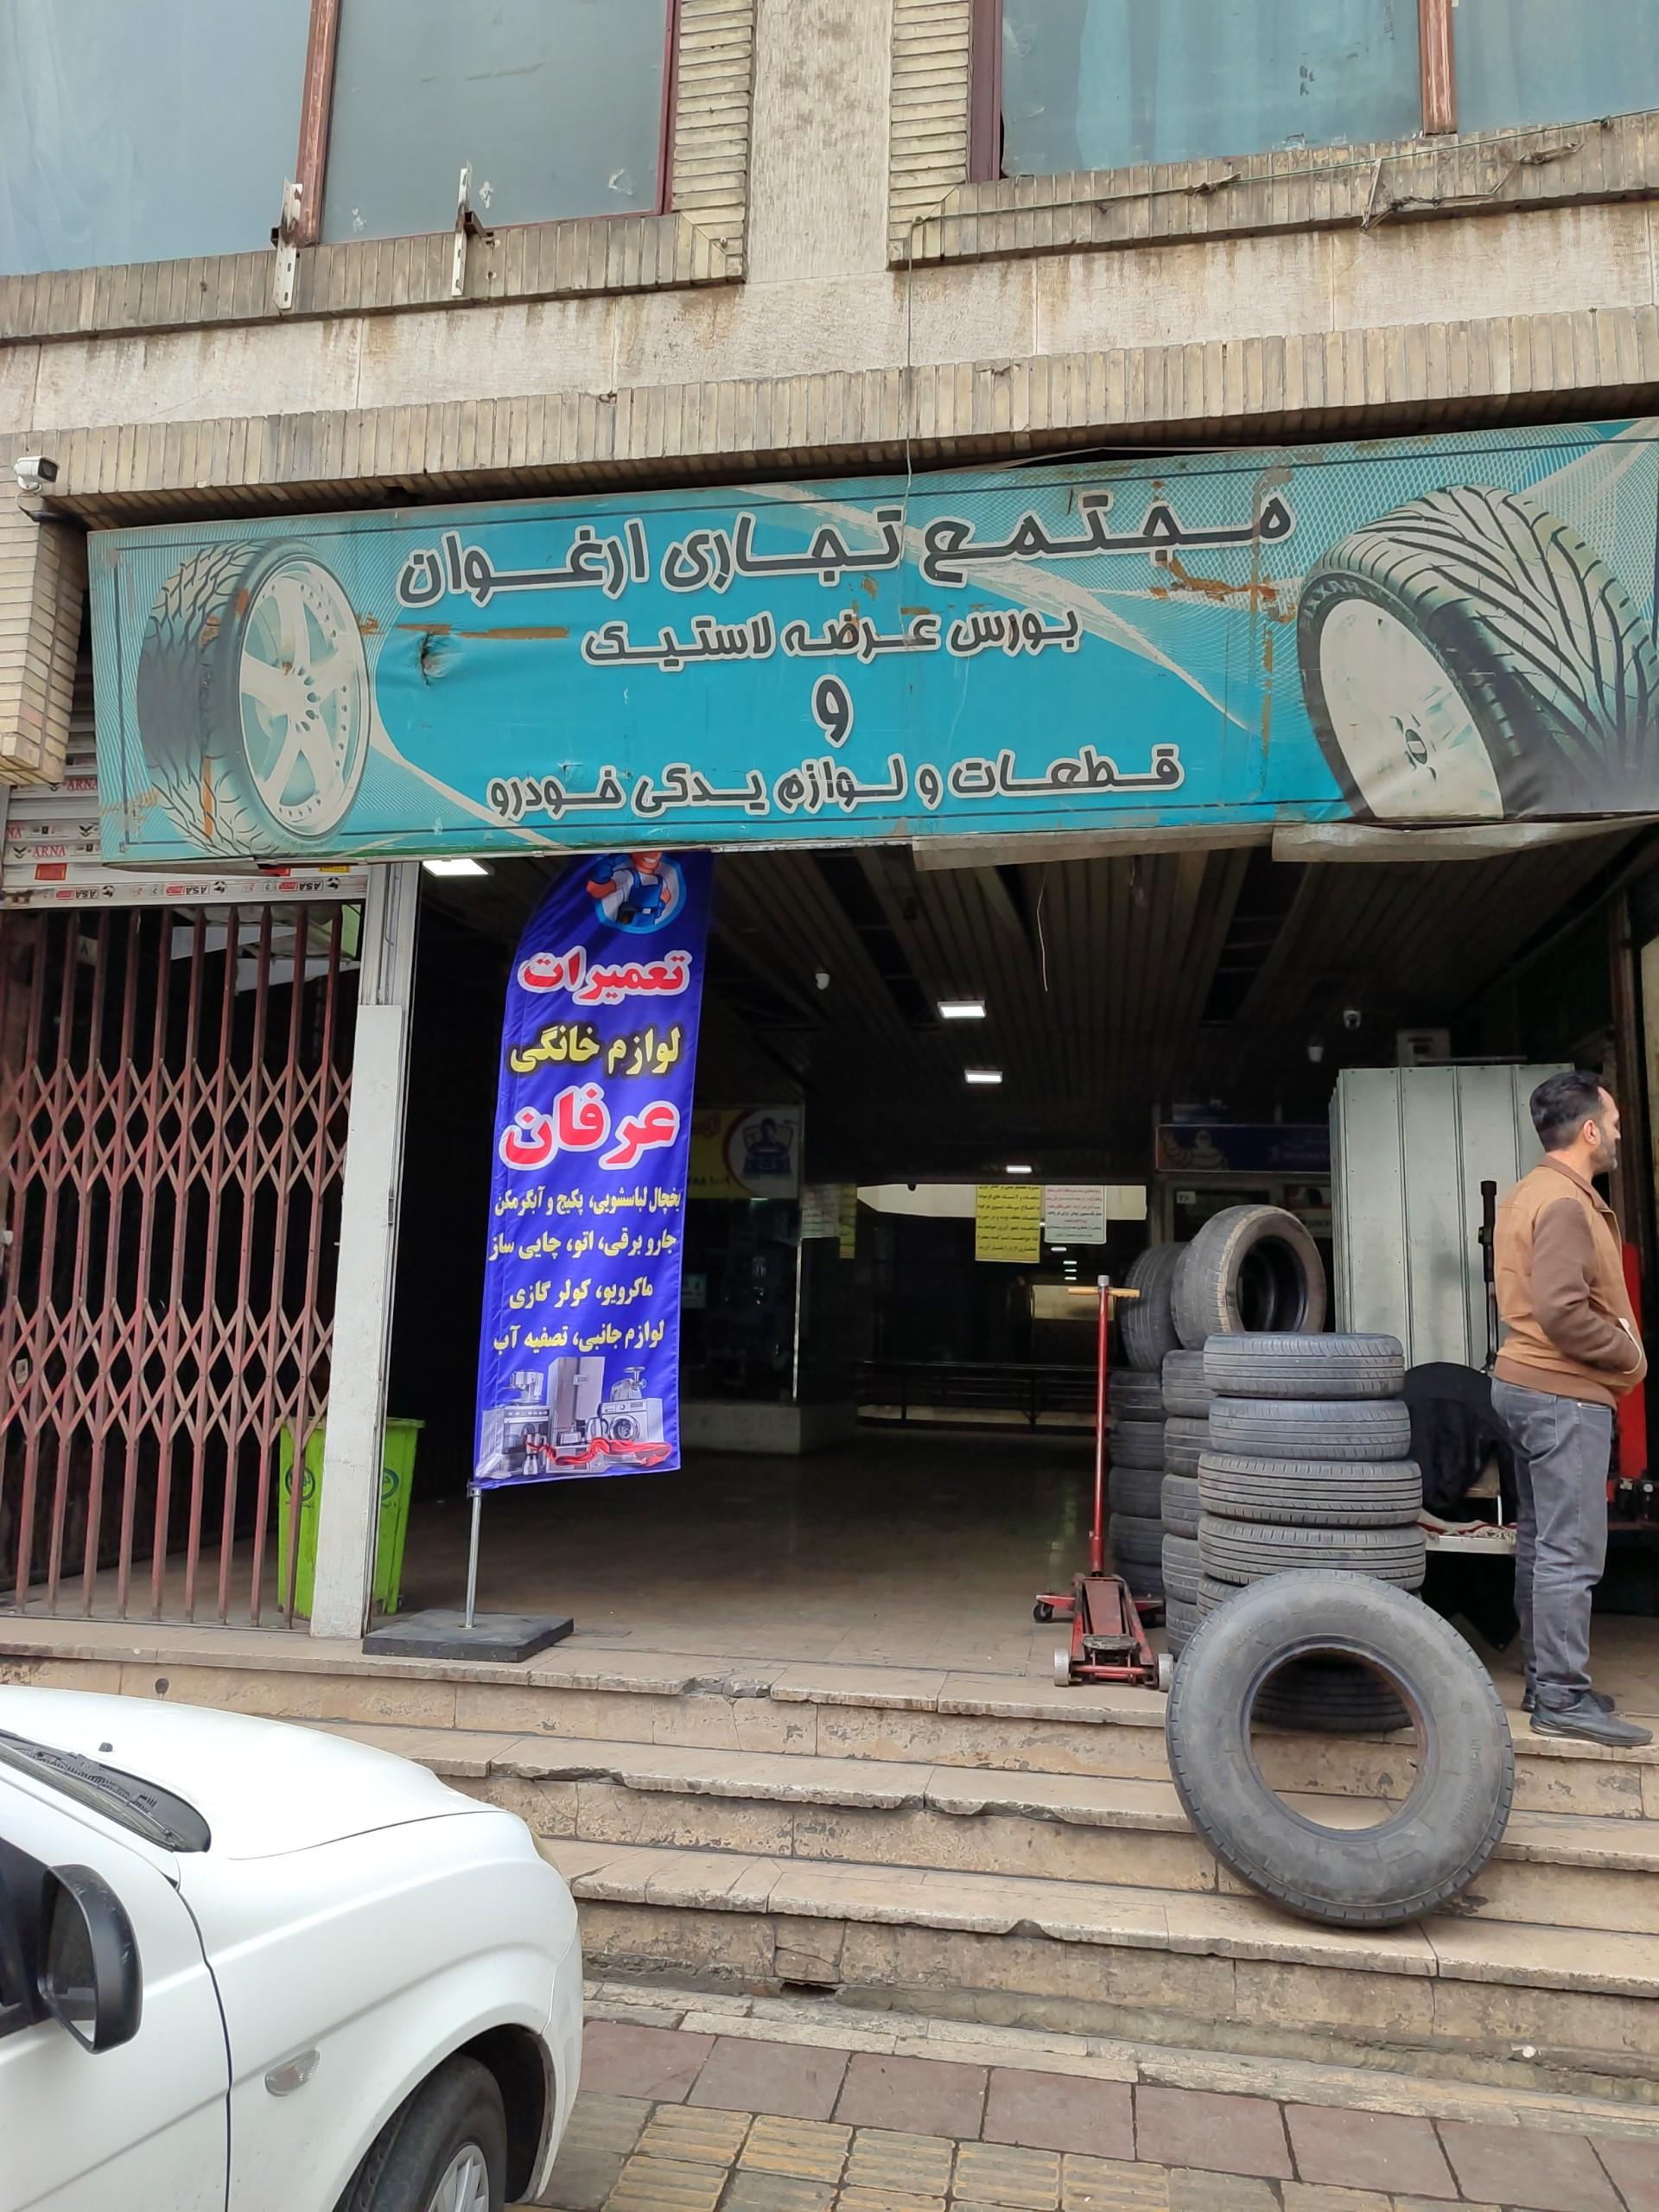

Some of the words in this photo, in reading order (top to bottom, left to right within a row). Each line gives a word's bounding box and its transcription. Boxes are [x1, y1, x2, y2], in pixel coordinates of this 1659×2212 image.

[396, 518, 648, 607] ارغوان
[661, 506, 906, 593] تجاری
[921, 490, 1296, 587] مجتمع
[582, 611, 774, 671] لاستیک
[781, 609, 940, 664] عرضه
[947, 607, 1078, 657] بورس
[810, 674, 854, 747] و
[486, 765, 625, 818] خودرو
[631, 762, 766, 818] یدکی
[775, 753, 906, 814] لوازم
[916, 763, 943, 809] و
[948, 743, 1184, 798] قطعات
[32, 844, 66, 858] ARNA
[518, 945, 693, 1005] تعمیرات
[509, 1024, 601, 1073] خانگی
[607, 1026, 682, 1076] لوازم
[499, 1082, 679, 1170] عرفان
[545, 1196, 554, 1215] و
[556, 1188, 583, 1215] پکیج
[649, 1186, 681, 1215] یخچال
[488, 1232, 515, 1262] ساز
[518, 1230, 562, 1260] چایی
[645, 1228, 677, 1256] جارو
[509, 1280, 551, 1309] گازی
[554, 1278, 592, 1308] کولر
[493, 1325, 521, 1355] آب
[524, 1325, 569, 1353] تصفیه
[625, 1319, 665, 1349] لوازم
